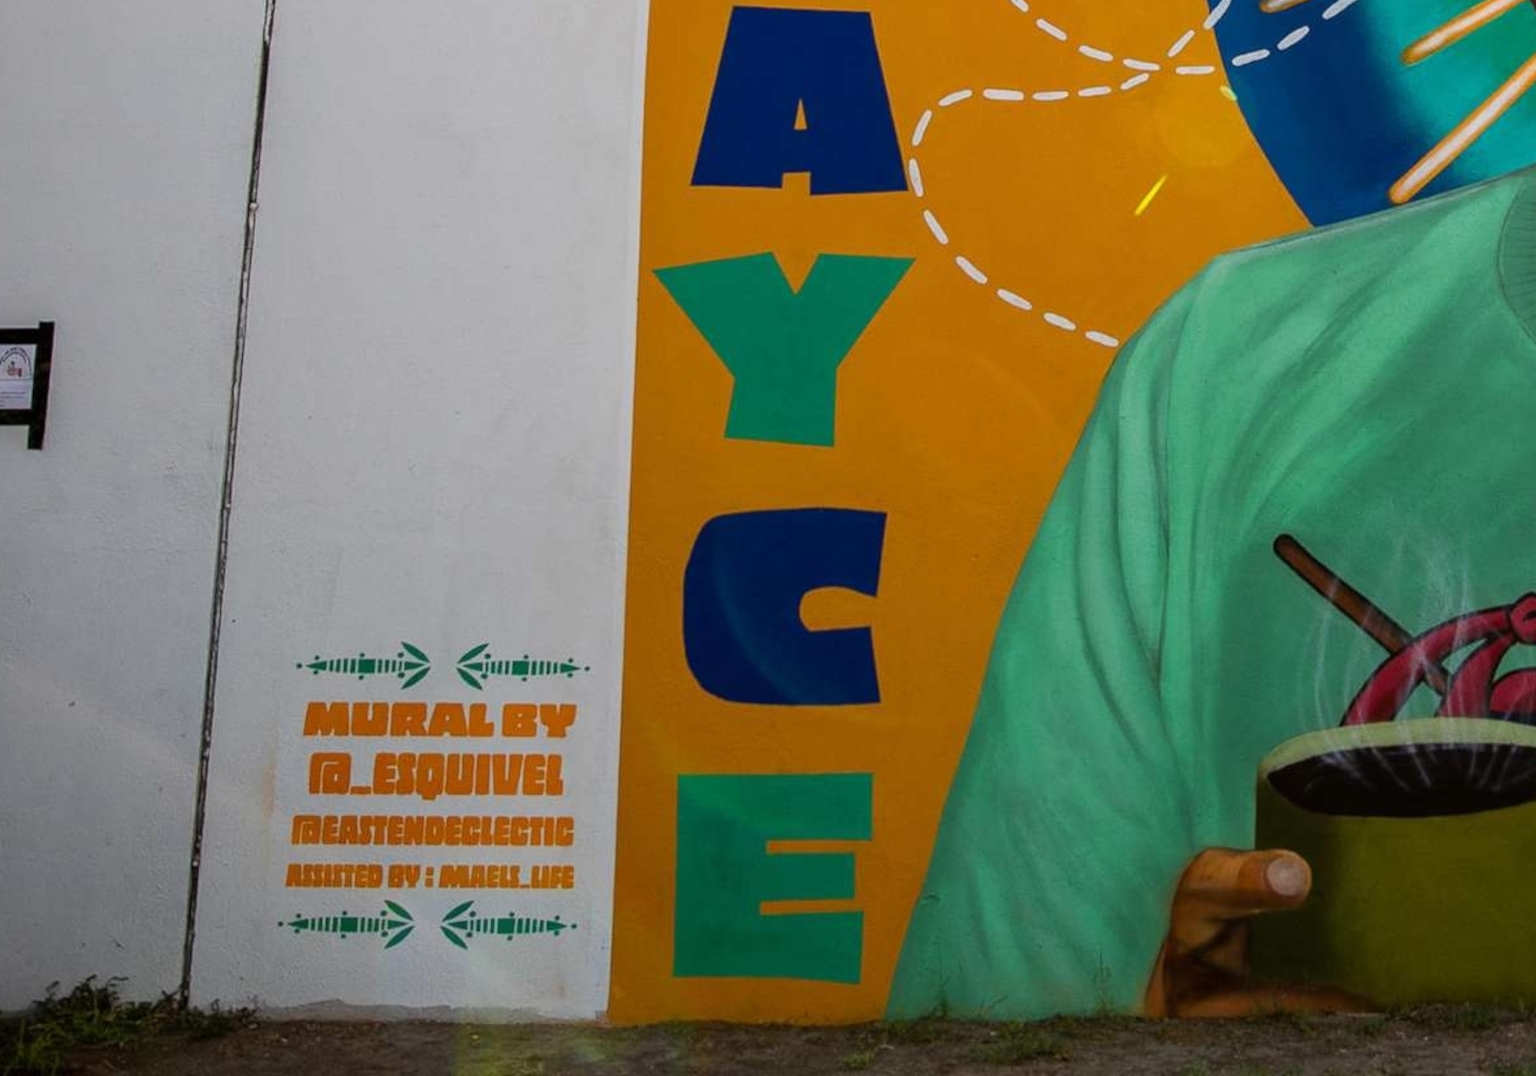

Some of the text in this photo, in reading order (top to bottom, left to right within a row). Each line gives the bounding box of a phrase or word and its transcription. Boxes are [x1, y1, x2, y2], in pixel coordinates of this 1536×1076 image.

[303, 701, 578, 739] MURAL BY
[308, 751, 564, 801] @_ESQUIVEL
[291, 814, 575, 847] @EASTENDECLECTIC
[285, 863, 384, 889] ASSISTED
[387, 864, 421, 889] BY
